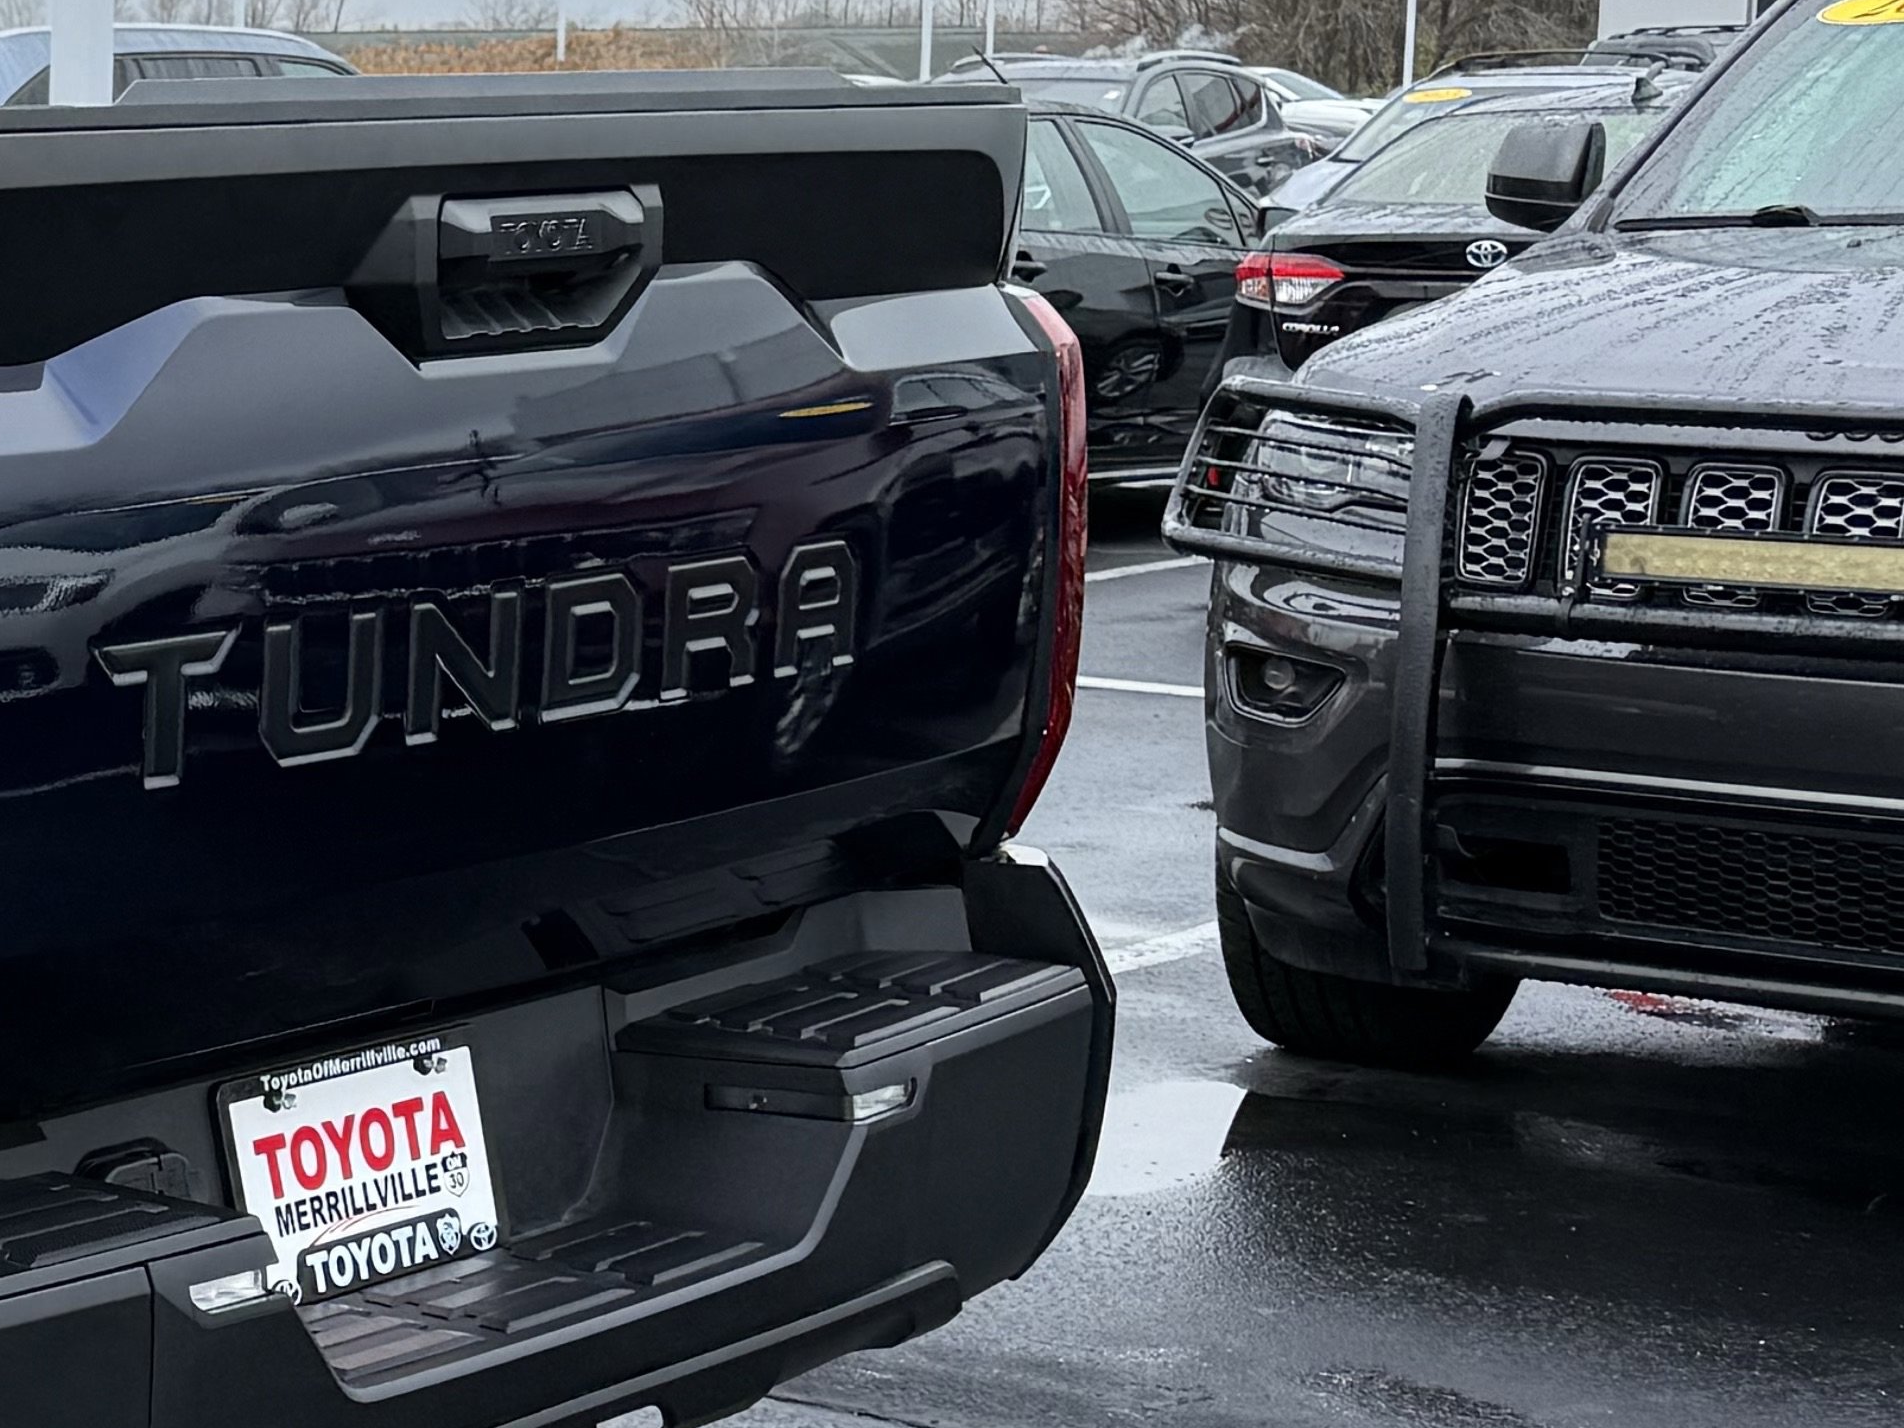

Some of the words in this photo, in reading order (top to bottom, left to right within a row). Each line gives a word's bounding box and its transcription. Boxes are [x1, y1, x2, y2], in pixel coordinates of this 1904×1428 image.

[499, 218, 593, 255] TOYOTA
[92, 540, 856, 789] TUNDRA
[253, 1090, 466, 1200] TOYOTA
[449, 1171, 465, 1189] 30
[275, 1162, 441, 1238] MERRILLVILLE
[305, 1221, 439, 1294] TOYOTA
